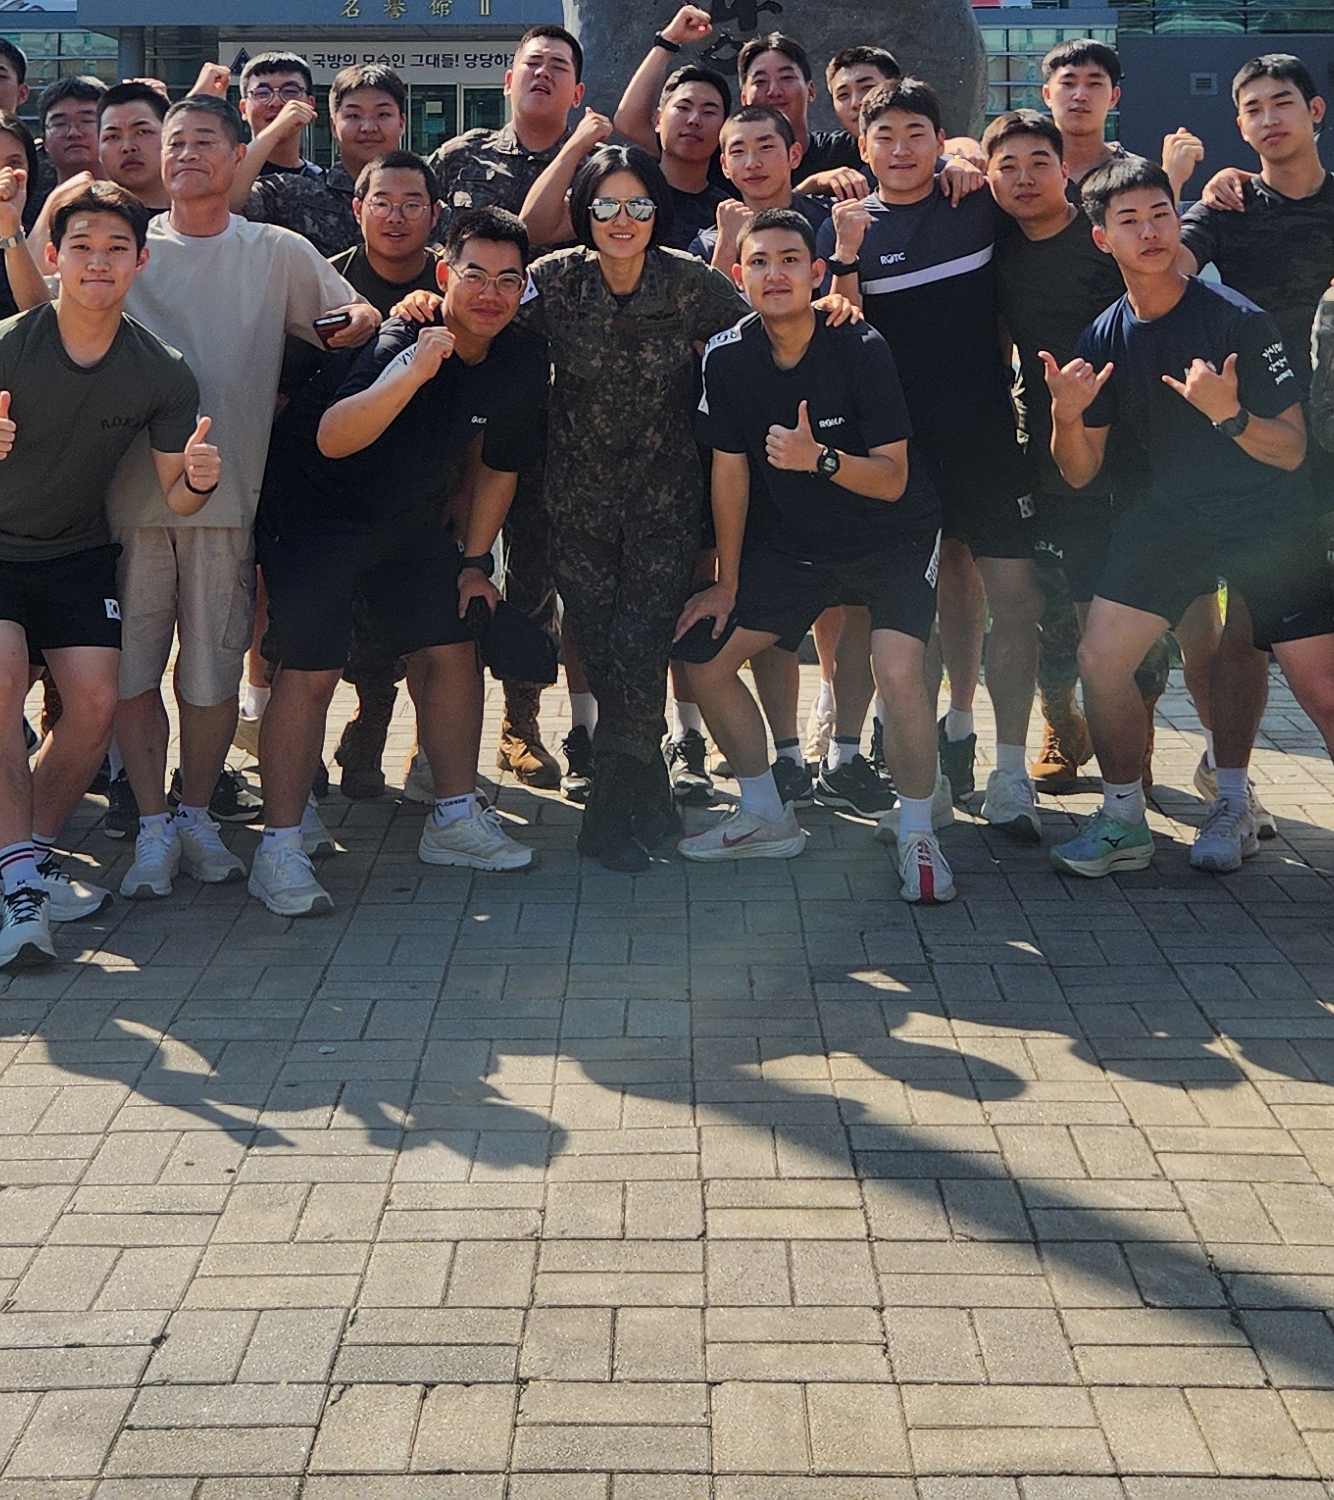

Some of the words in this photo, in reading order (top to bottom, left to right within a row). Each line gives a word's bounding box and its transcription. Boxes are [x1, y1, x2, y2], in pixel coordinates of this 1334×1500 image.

[311, 53, 357, 70] 국방의
[410, 53, 459, 69] 그대들!
[880, 251, 906, 265] ROTC
